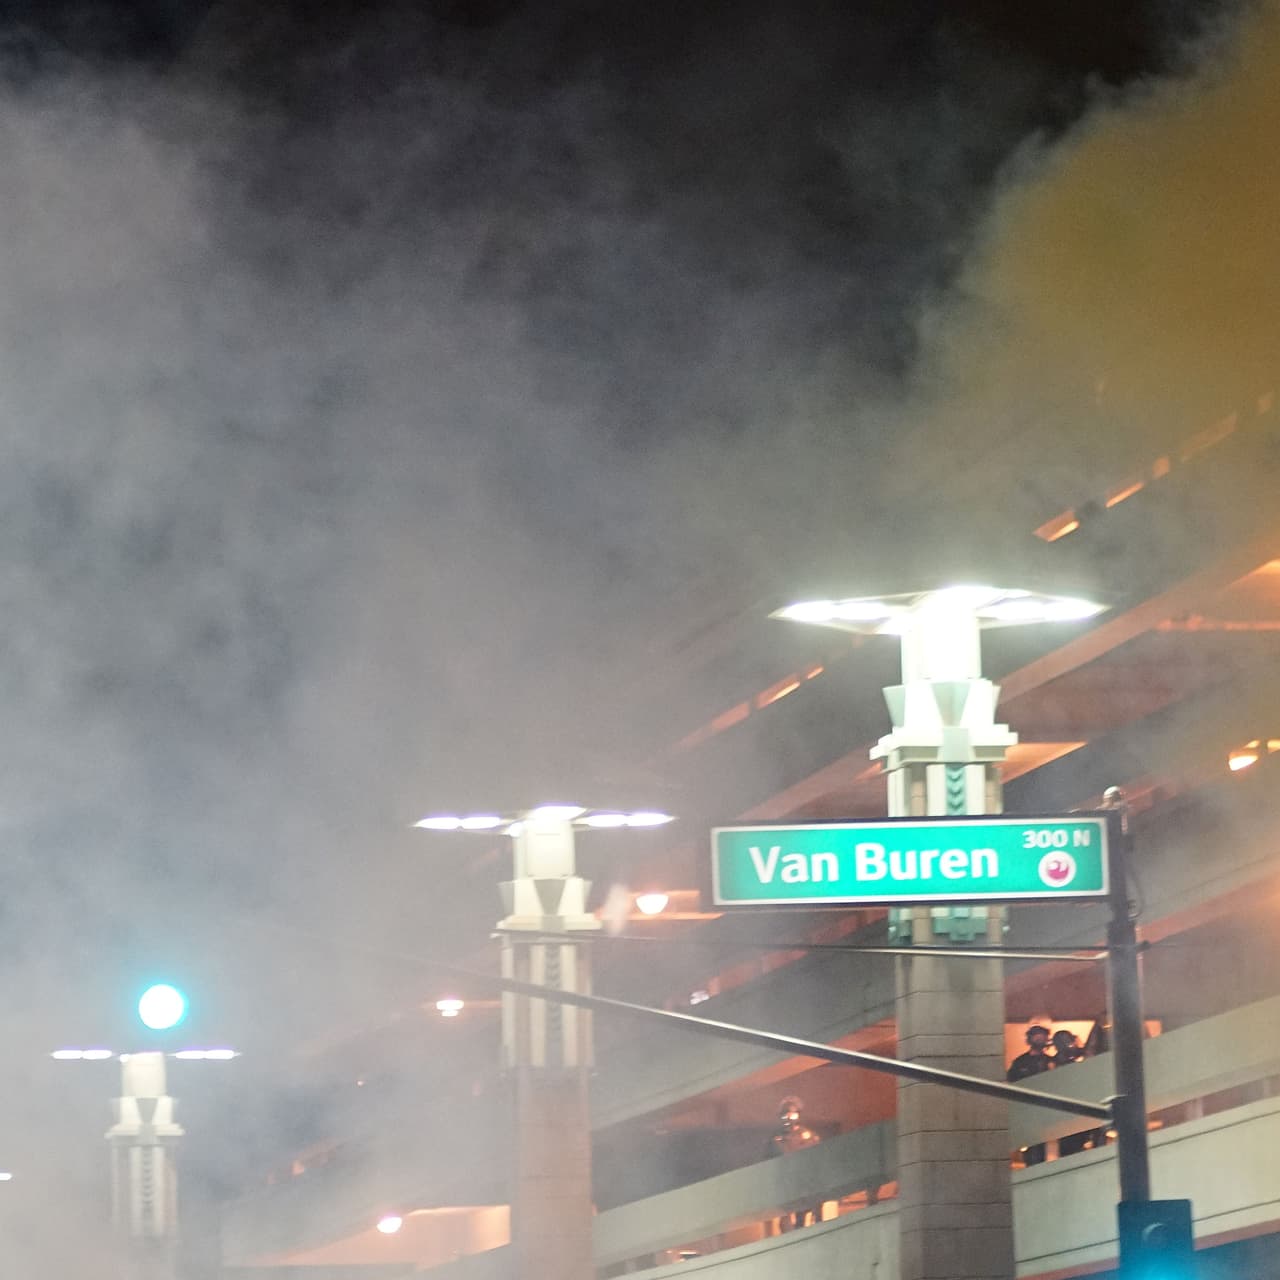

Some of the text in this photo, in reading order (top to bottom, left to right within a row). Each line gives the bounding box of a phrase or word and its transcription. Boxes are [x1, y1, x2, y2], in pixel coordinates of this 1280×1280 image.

[1022, 829, 1069, 849] 300
[749, 842, 1000, 884] Van Buren
